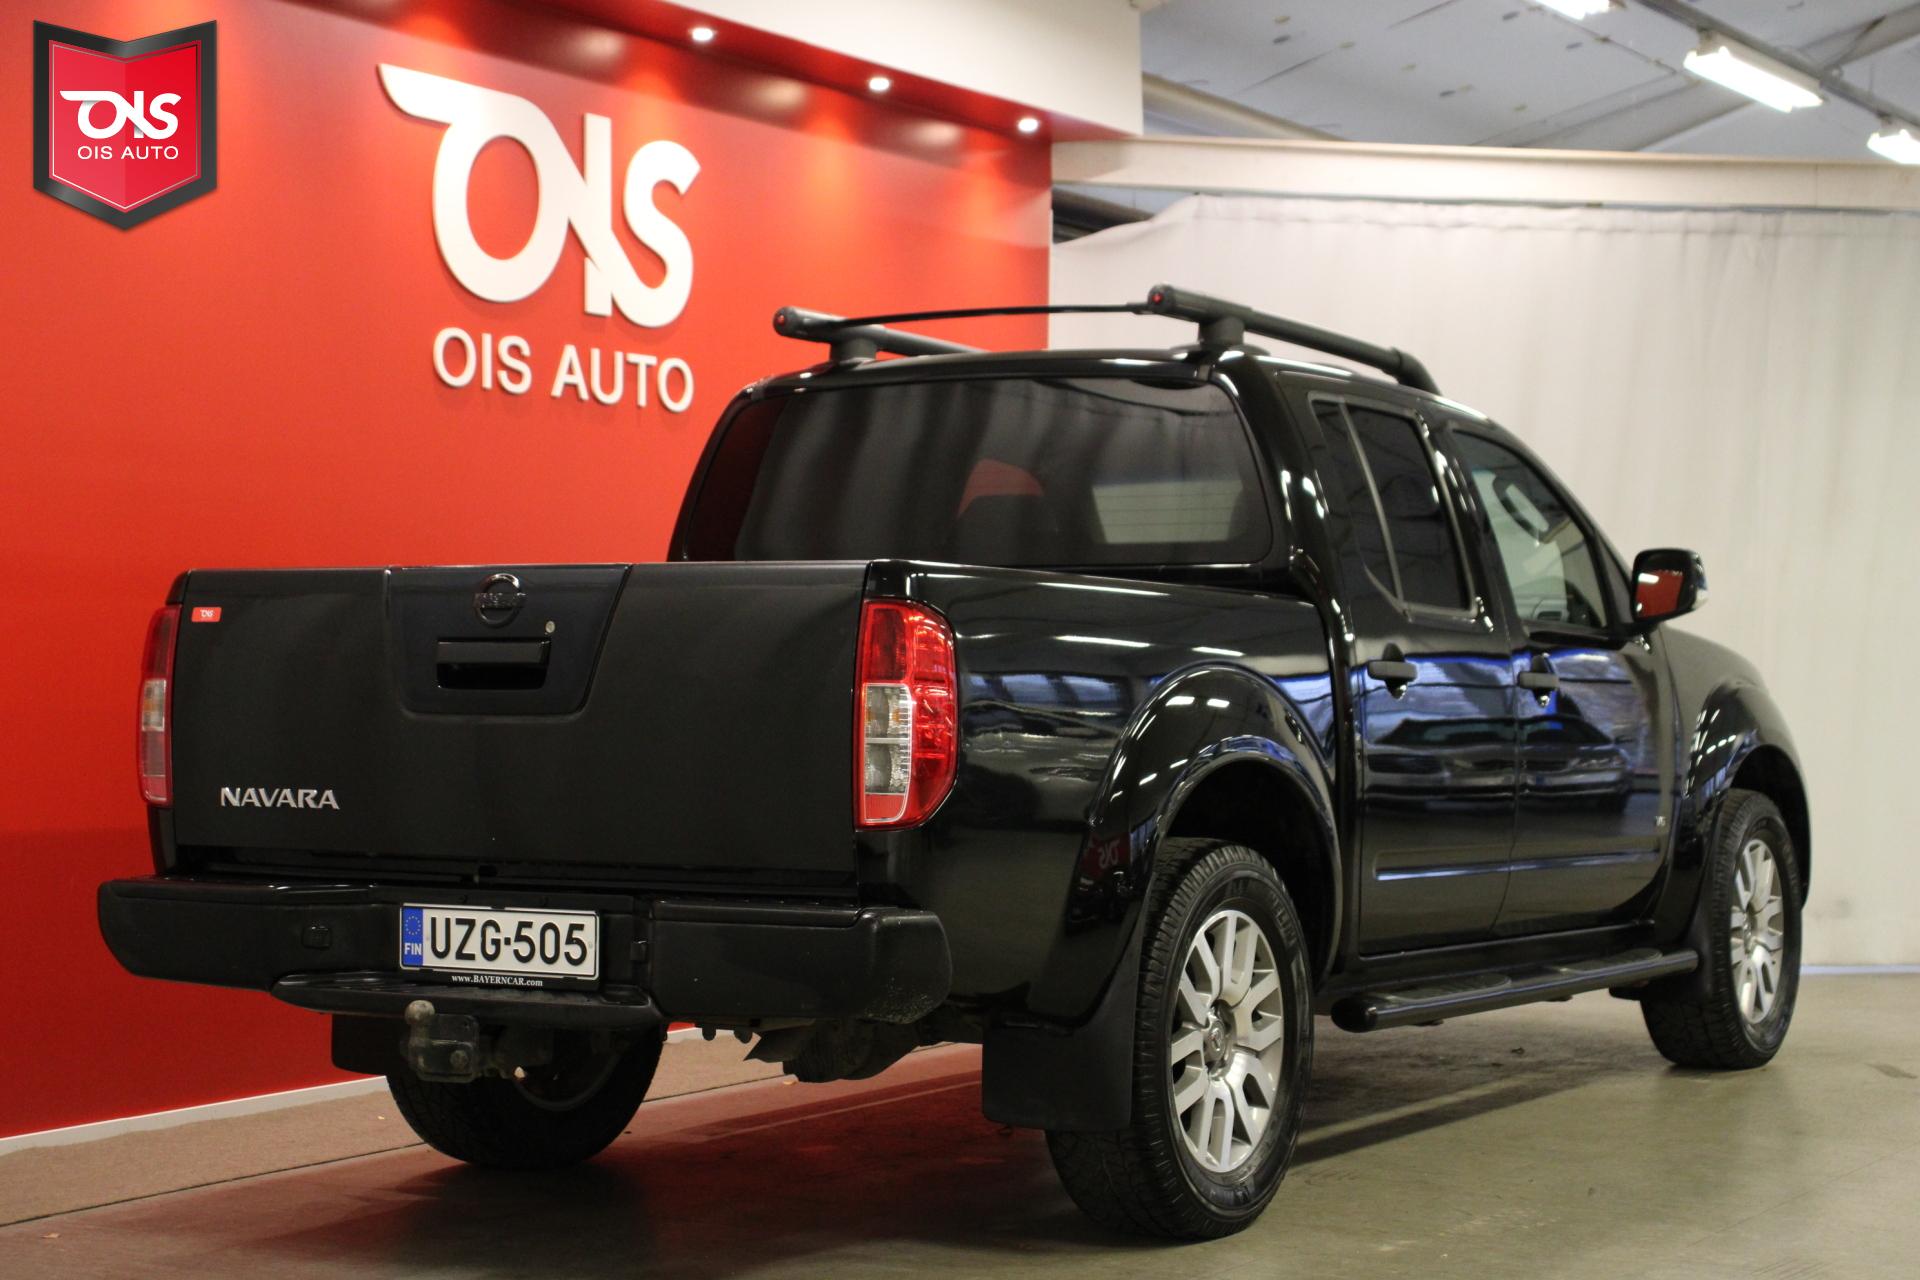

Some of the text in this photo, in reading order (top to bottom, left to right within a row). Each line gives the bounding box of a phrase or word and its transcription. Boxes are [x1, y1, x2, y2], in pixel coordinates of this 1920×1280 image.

[432, 327, 695, 413] OIS AUTO
[220, 787, 340, 810] NAVARA
[403, 941, 423, 956] FIN
[430, 916, 588, 967] UZG-505
[451, 974, 544, 988] www.BAYERNCAR.com
